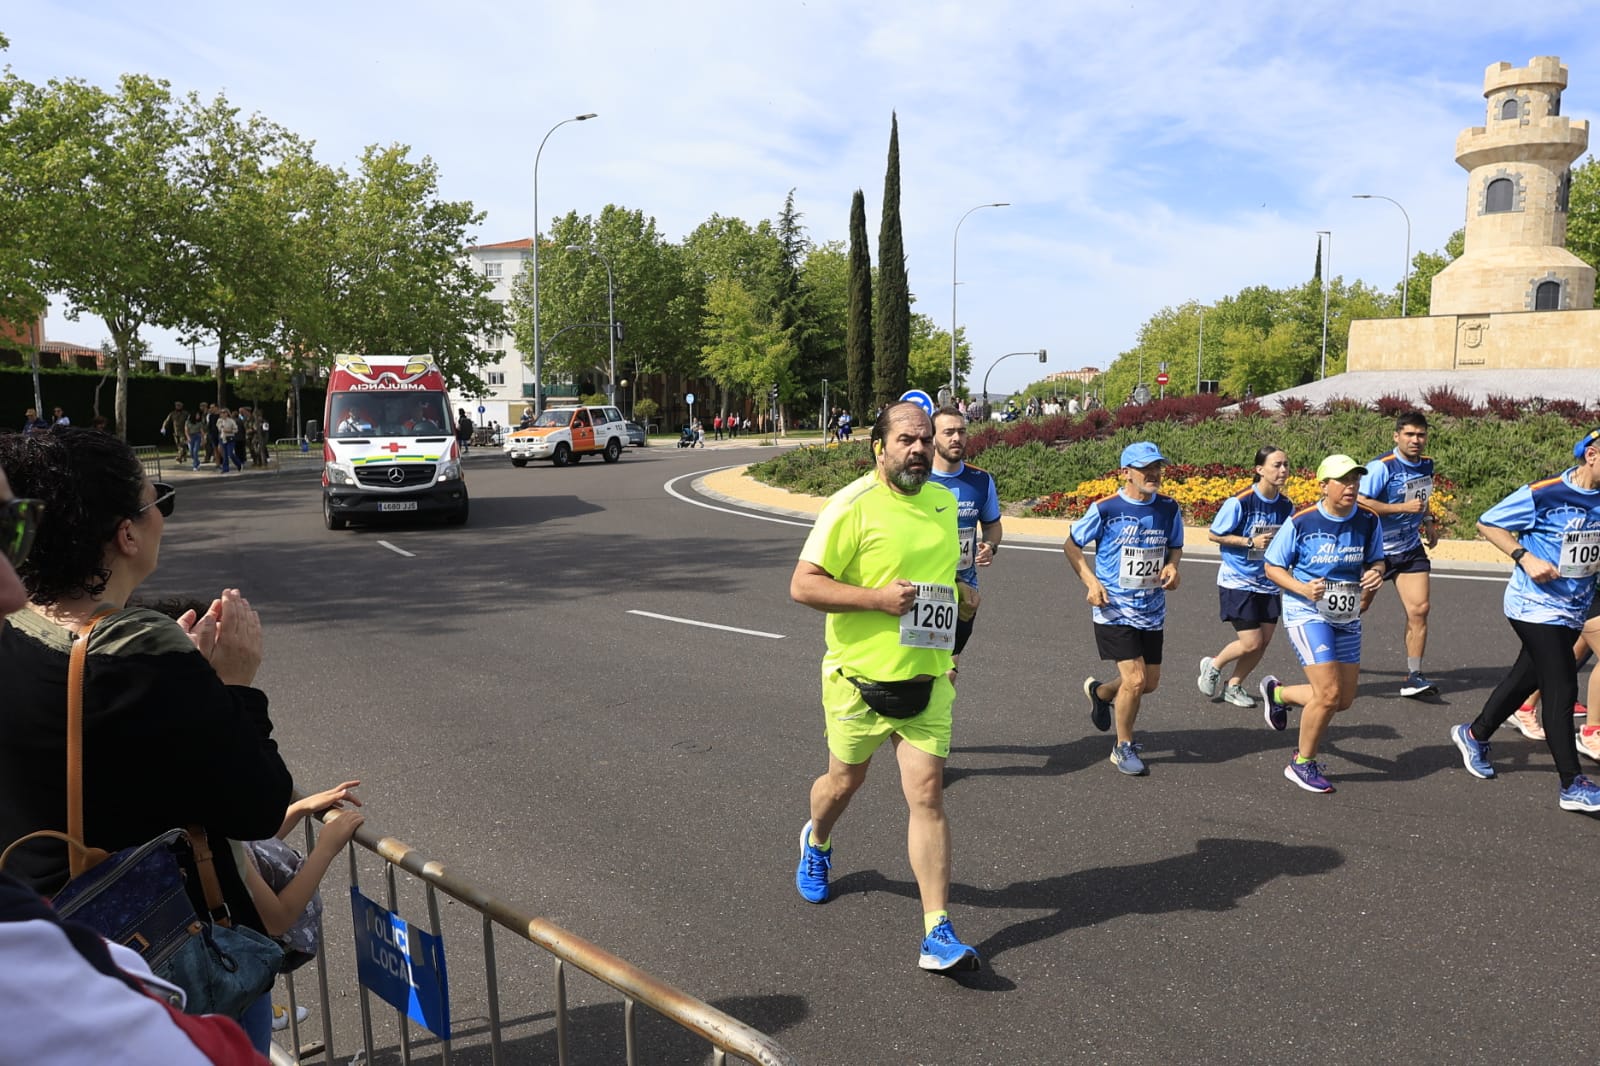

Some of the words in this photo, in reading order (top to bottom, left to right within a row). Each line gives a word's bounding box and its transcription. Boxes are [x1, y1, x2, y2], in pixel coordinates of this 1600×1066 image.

[1564, 517, 1586, 530] XII
[1122, 525, 1138, 536] XII
[1567, 533, 1579, 542] XII
[1125, 548, 1135, 557] XII
[1316, 543, 1335, 554] XII
[1569, 545, 1600, 563] 109
[1127, 561, 1160, 576] 1224
[1328, 594, 1355, 612] 939
[910, 602, 953, 630] 1260
